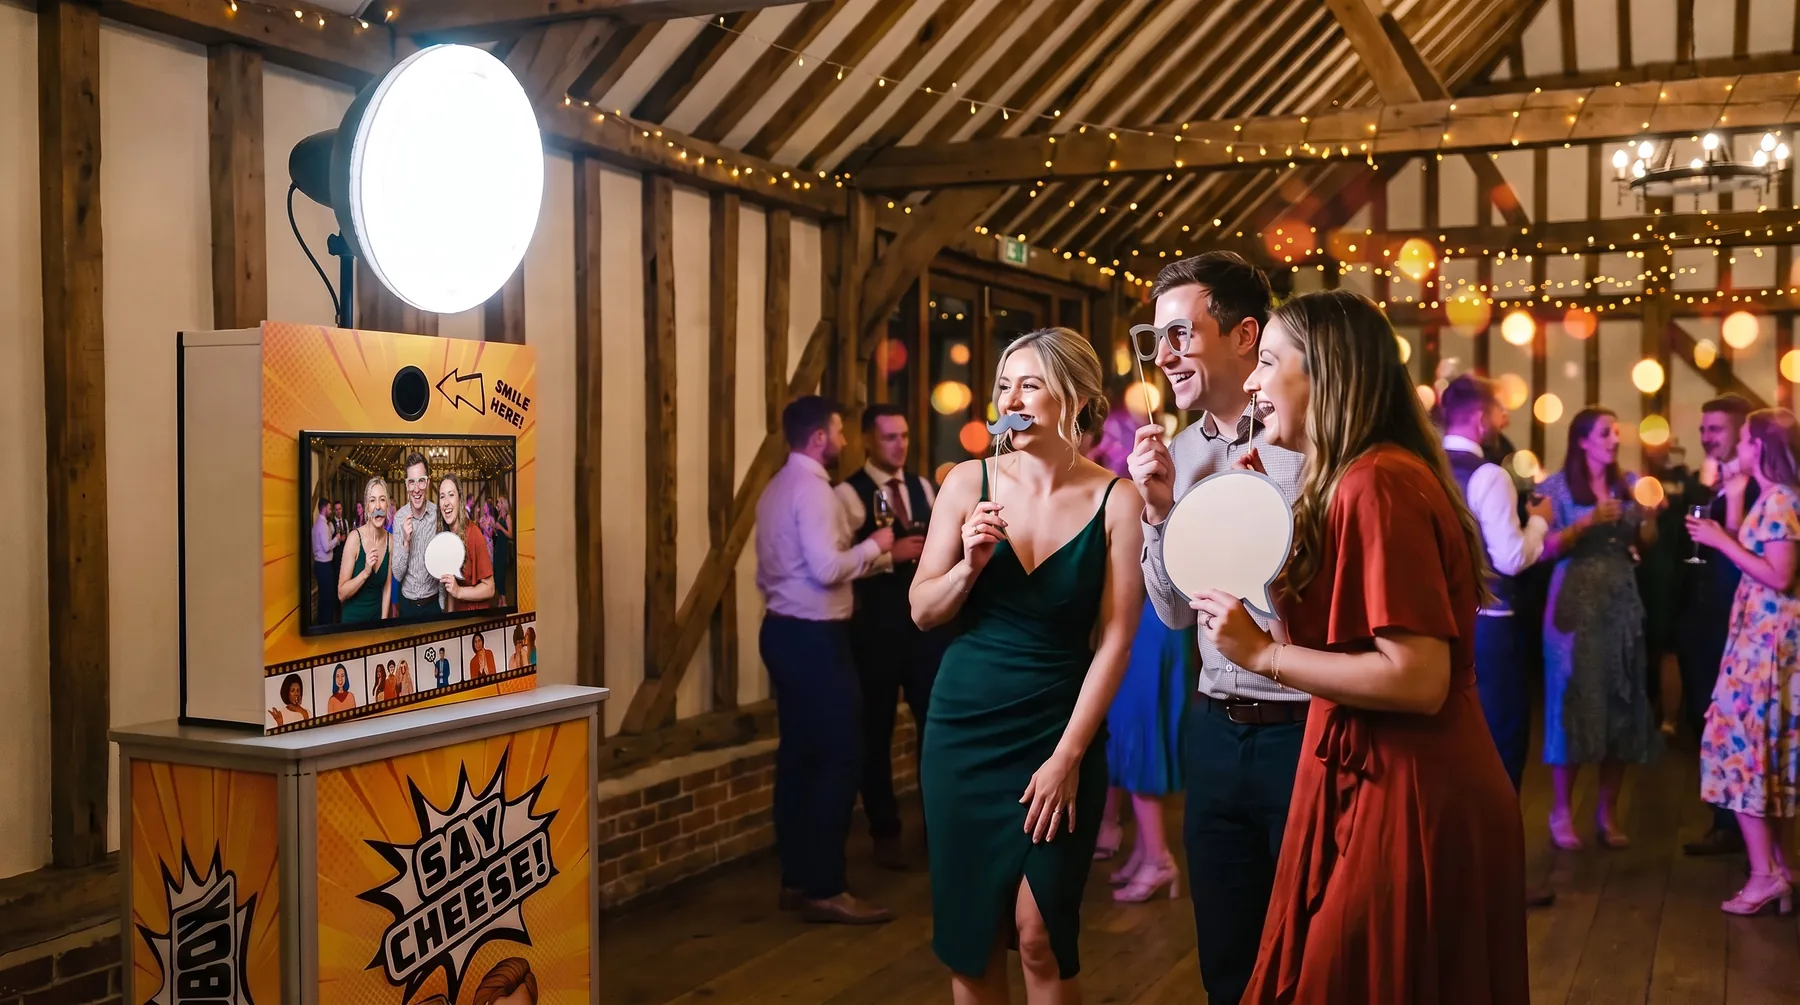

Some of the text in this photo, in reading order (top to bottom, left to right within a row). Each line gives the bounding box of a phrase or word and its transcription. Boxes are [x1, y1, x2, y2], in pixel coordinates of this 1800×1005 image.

[490, 397, 525, 429] HERE!
[495, 379, 531, 411] SMILE
[420, 805, 498, 890] SAY
[177, 881, 232, 1005] BOX
[389, 838, 547, 974] CHEESE!
